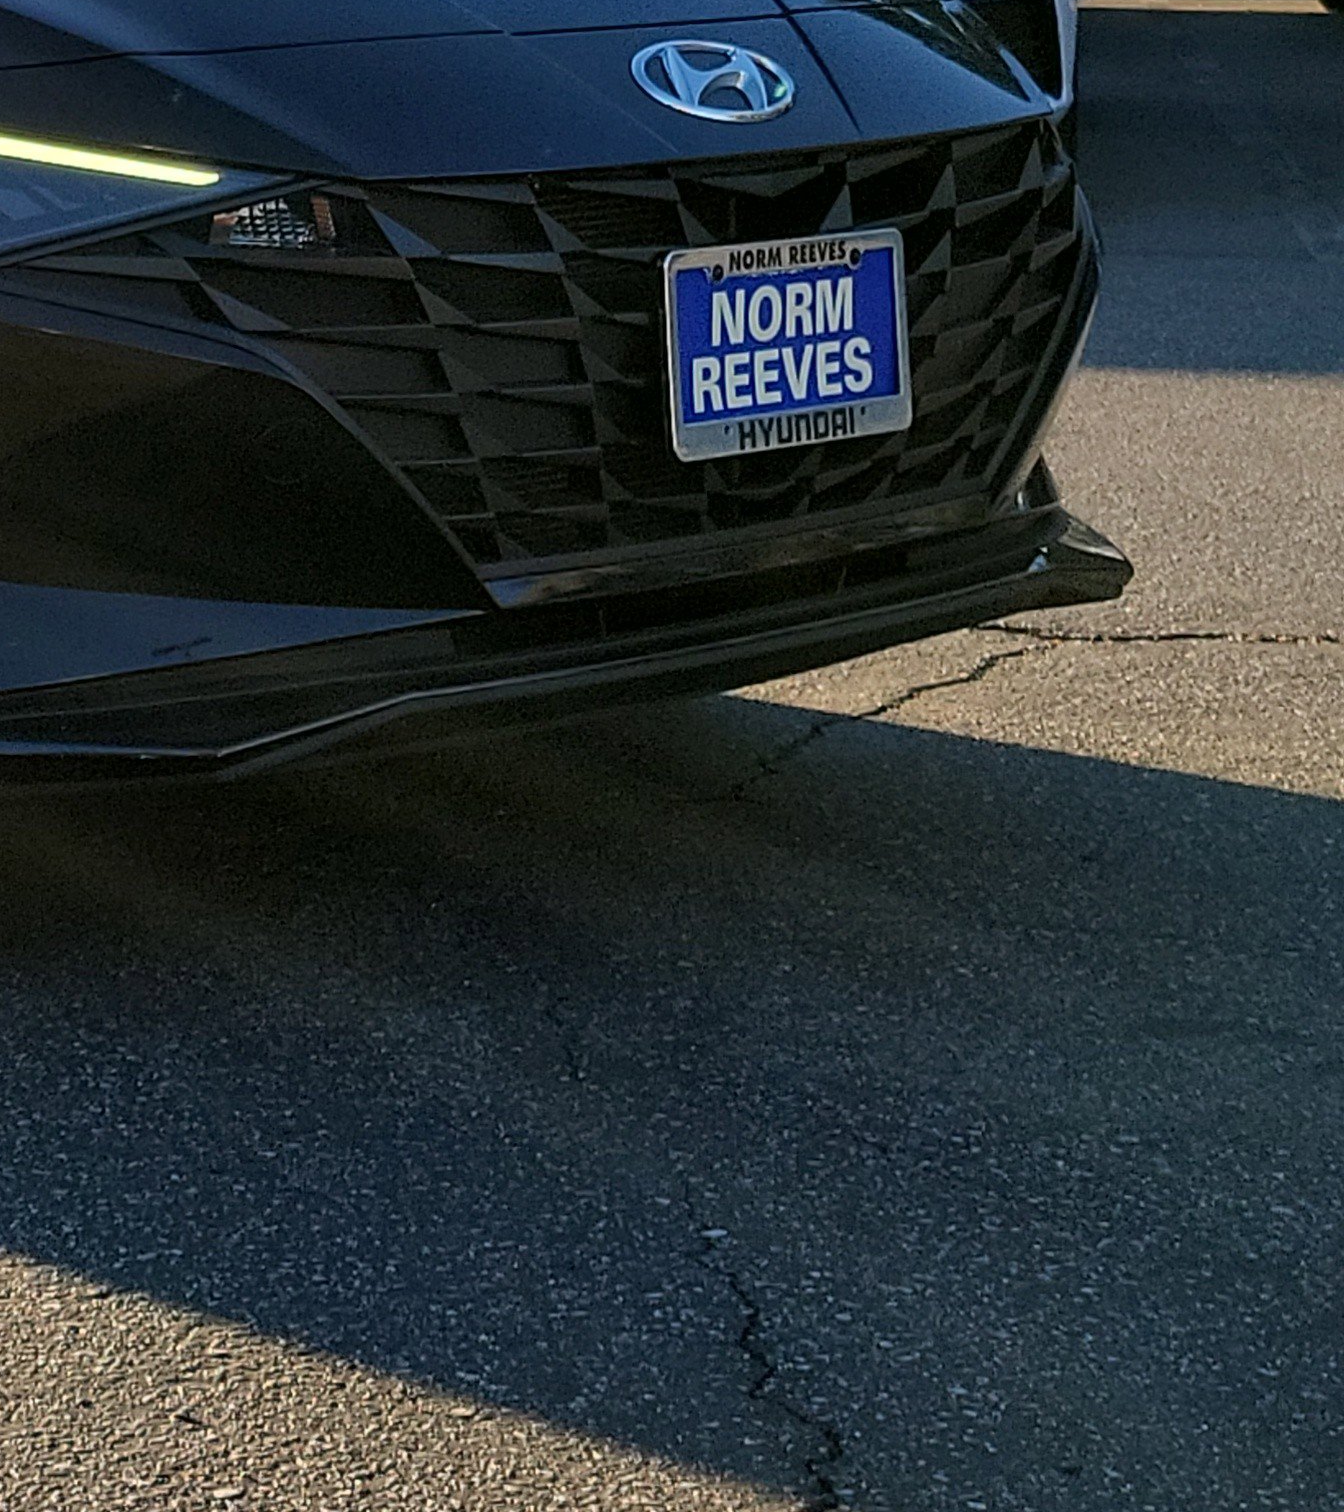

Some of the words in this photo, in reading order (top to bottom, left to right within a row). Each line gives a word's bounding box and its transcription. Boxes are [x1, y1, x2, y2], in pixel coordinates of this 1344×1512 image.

[728, 248, 782, 273] NORM
[788, 240, 847, 266] REEVES
[711, 276, 855, 347] NORM
[692, 338, 874, 415] REEVES
[738, 407, 856, 451] HYUNDAI
